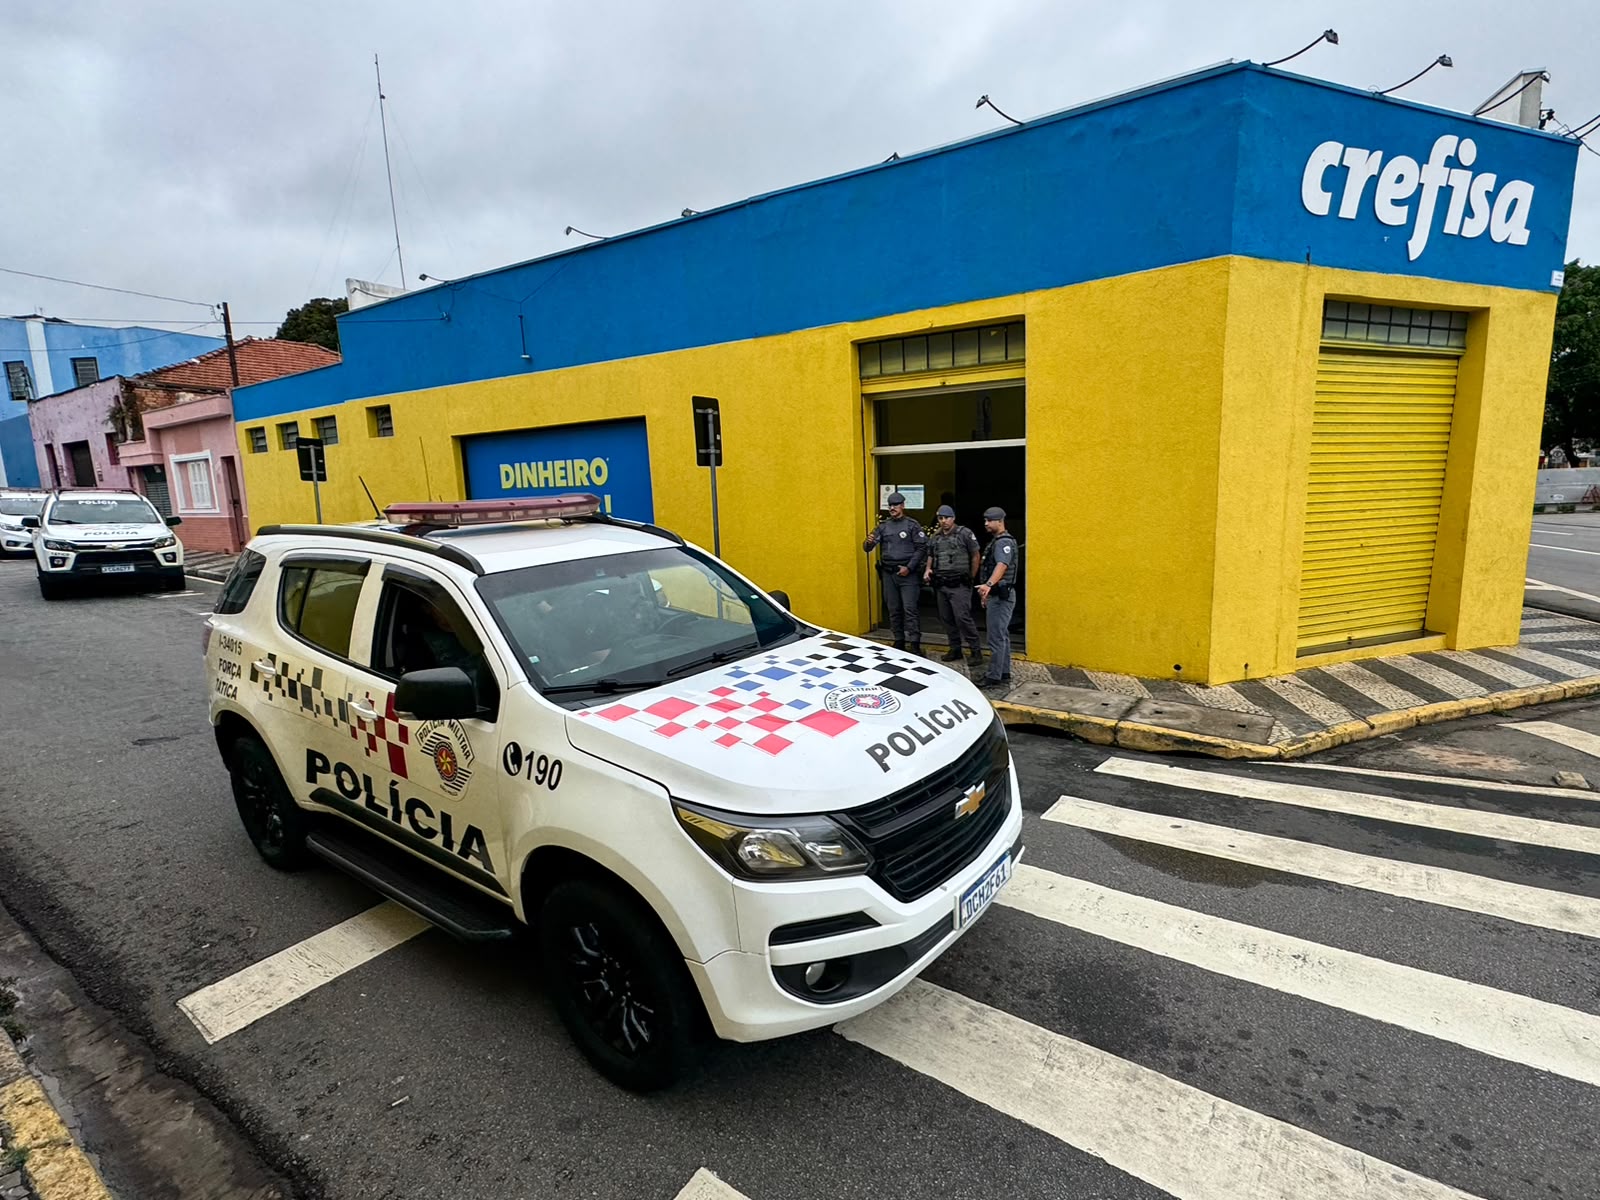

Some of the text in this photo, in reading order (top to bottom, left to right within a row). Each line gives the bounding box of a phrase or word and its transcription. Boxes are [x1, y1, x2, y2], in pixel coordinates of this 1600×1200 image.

[1301, 134, 1535, 262] crefisa
[218, 657, 242, 680] FORÇA
[447, 719, 471, 760] MILITAR
[865, 698, 979, 773] POLÍCIA
[524, 750, 563, 791] 190
[305, 748, 496, 875] POLÍCIA
[966, 863, 1007, 921] DCH2F61
